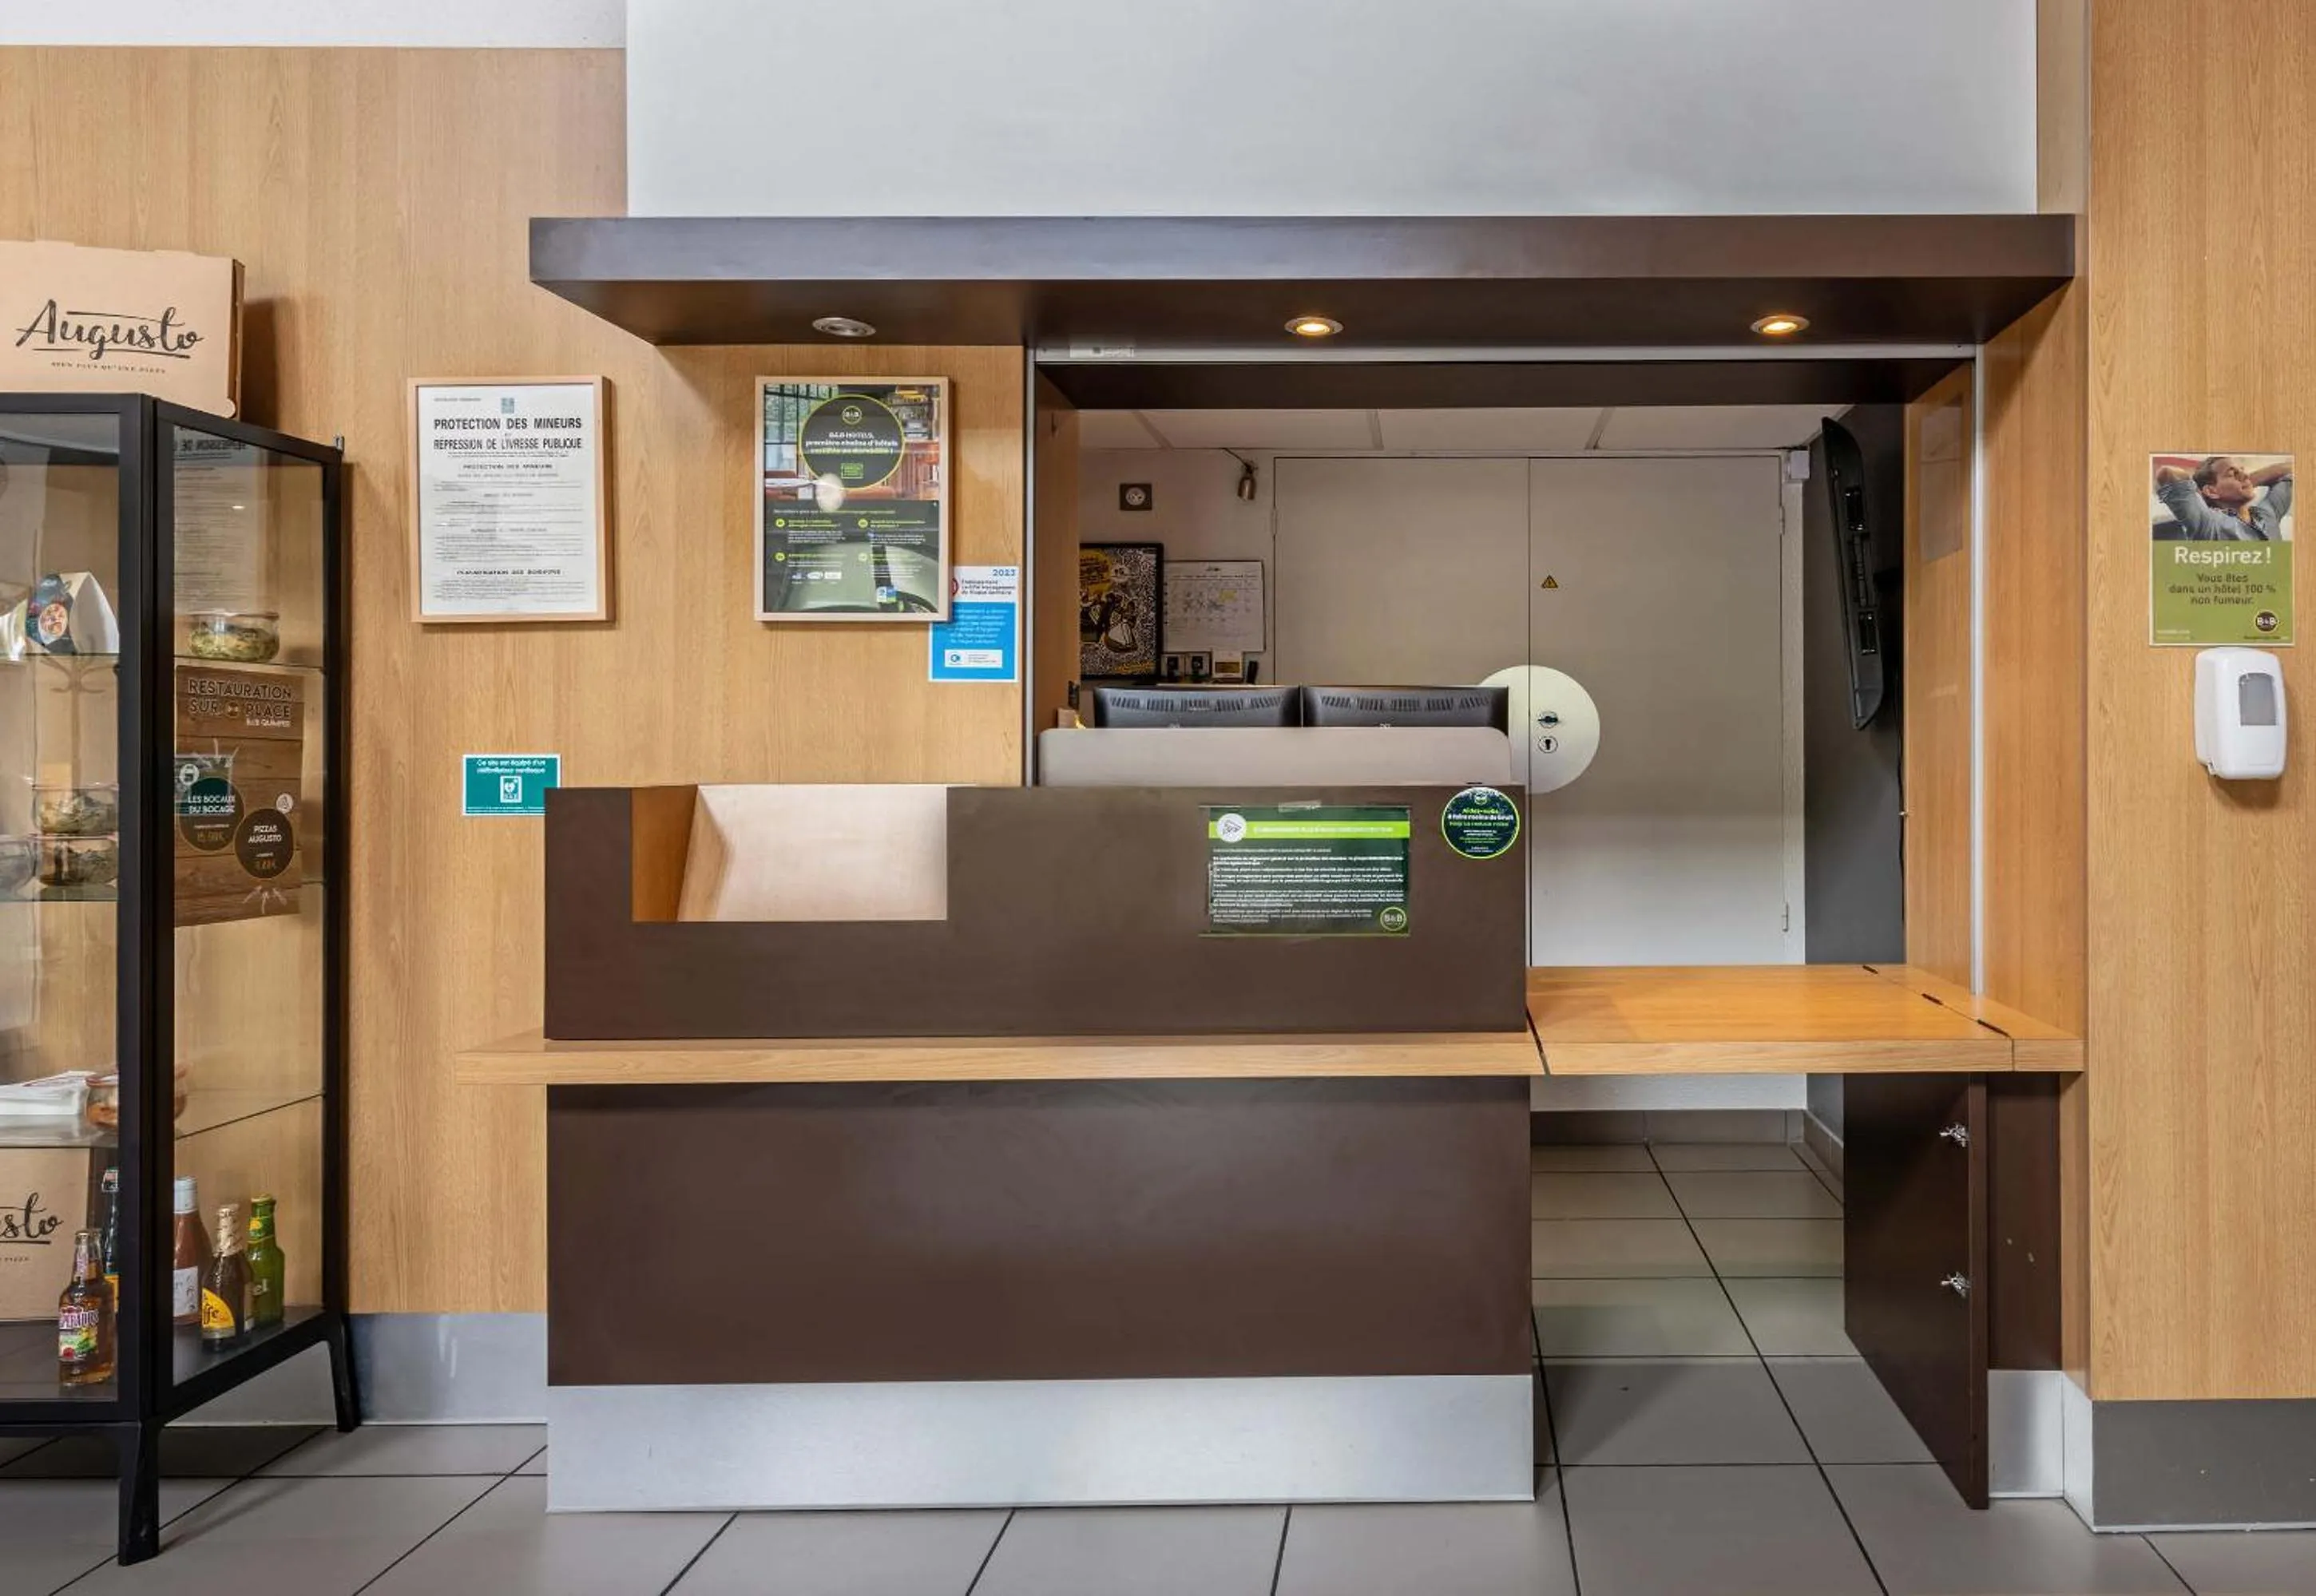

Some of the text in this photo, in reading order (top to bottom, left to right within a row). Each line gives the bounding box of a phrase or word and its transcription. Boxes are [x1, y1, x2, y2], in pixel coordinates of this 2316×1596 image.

[16, 299, 203, 360] Augusto
[434, 418, 581, 430] PROTECTION DES MINEURS
[486, 439, 497, 449] DE
[543, 438, 581, 449] PUBLIQUE
[2197, 572, 2249, 582] Vous êtes
[2169, 584, 2195, 594] dans
[2214, 584, 2241, 594] hôtel
[2245, 584, 2262, 594] 100
[2266, 584, 2276, 593] %
[2191, 596, 2211, 605] non
[188, 679, 291, 699] RESTAURATION
[190, 698, 291, 718] SUR PLACE
[248, 834, 282, 843] AUGUSTO
